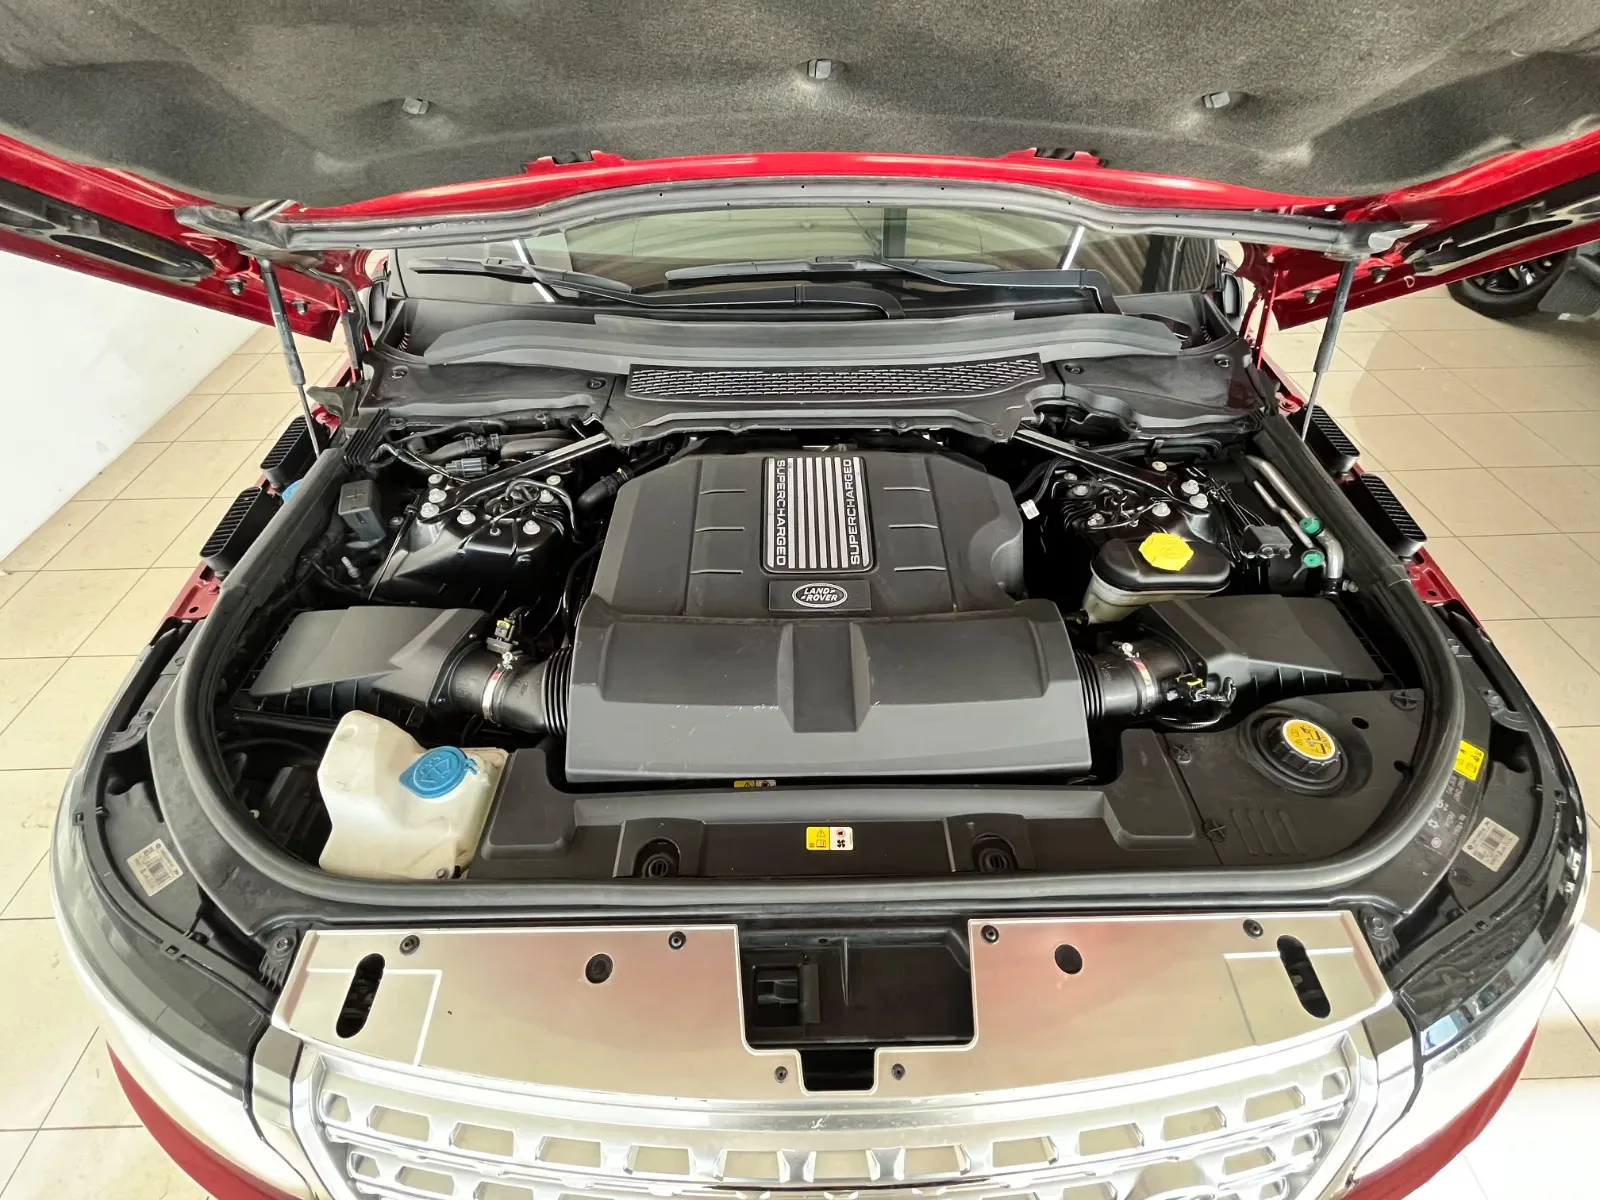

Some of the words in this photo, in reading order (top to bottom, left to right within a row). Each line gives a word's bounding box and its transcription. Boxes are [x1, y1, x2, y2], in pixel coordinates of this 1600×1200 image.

[776, 459, 786, 566] SUPERCHARGED
[843, 459, 860, 565] SUPERCHARGED
[803, 587, 831, 595] LAND
[805, 594, 838, 602] ROVER
